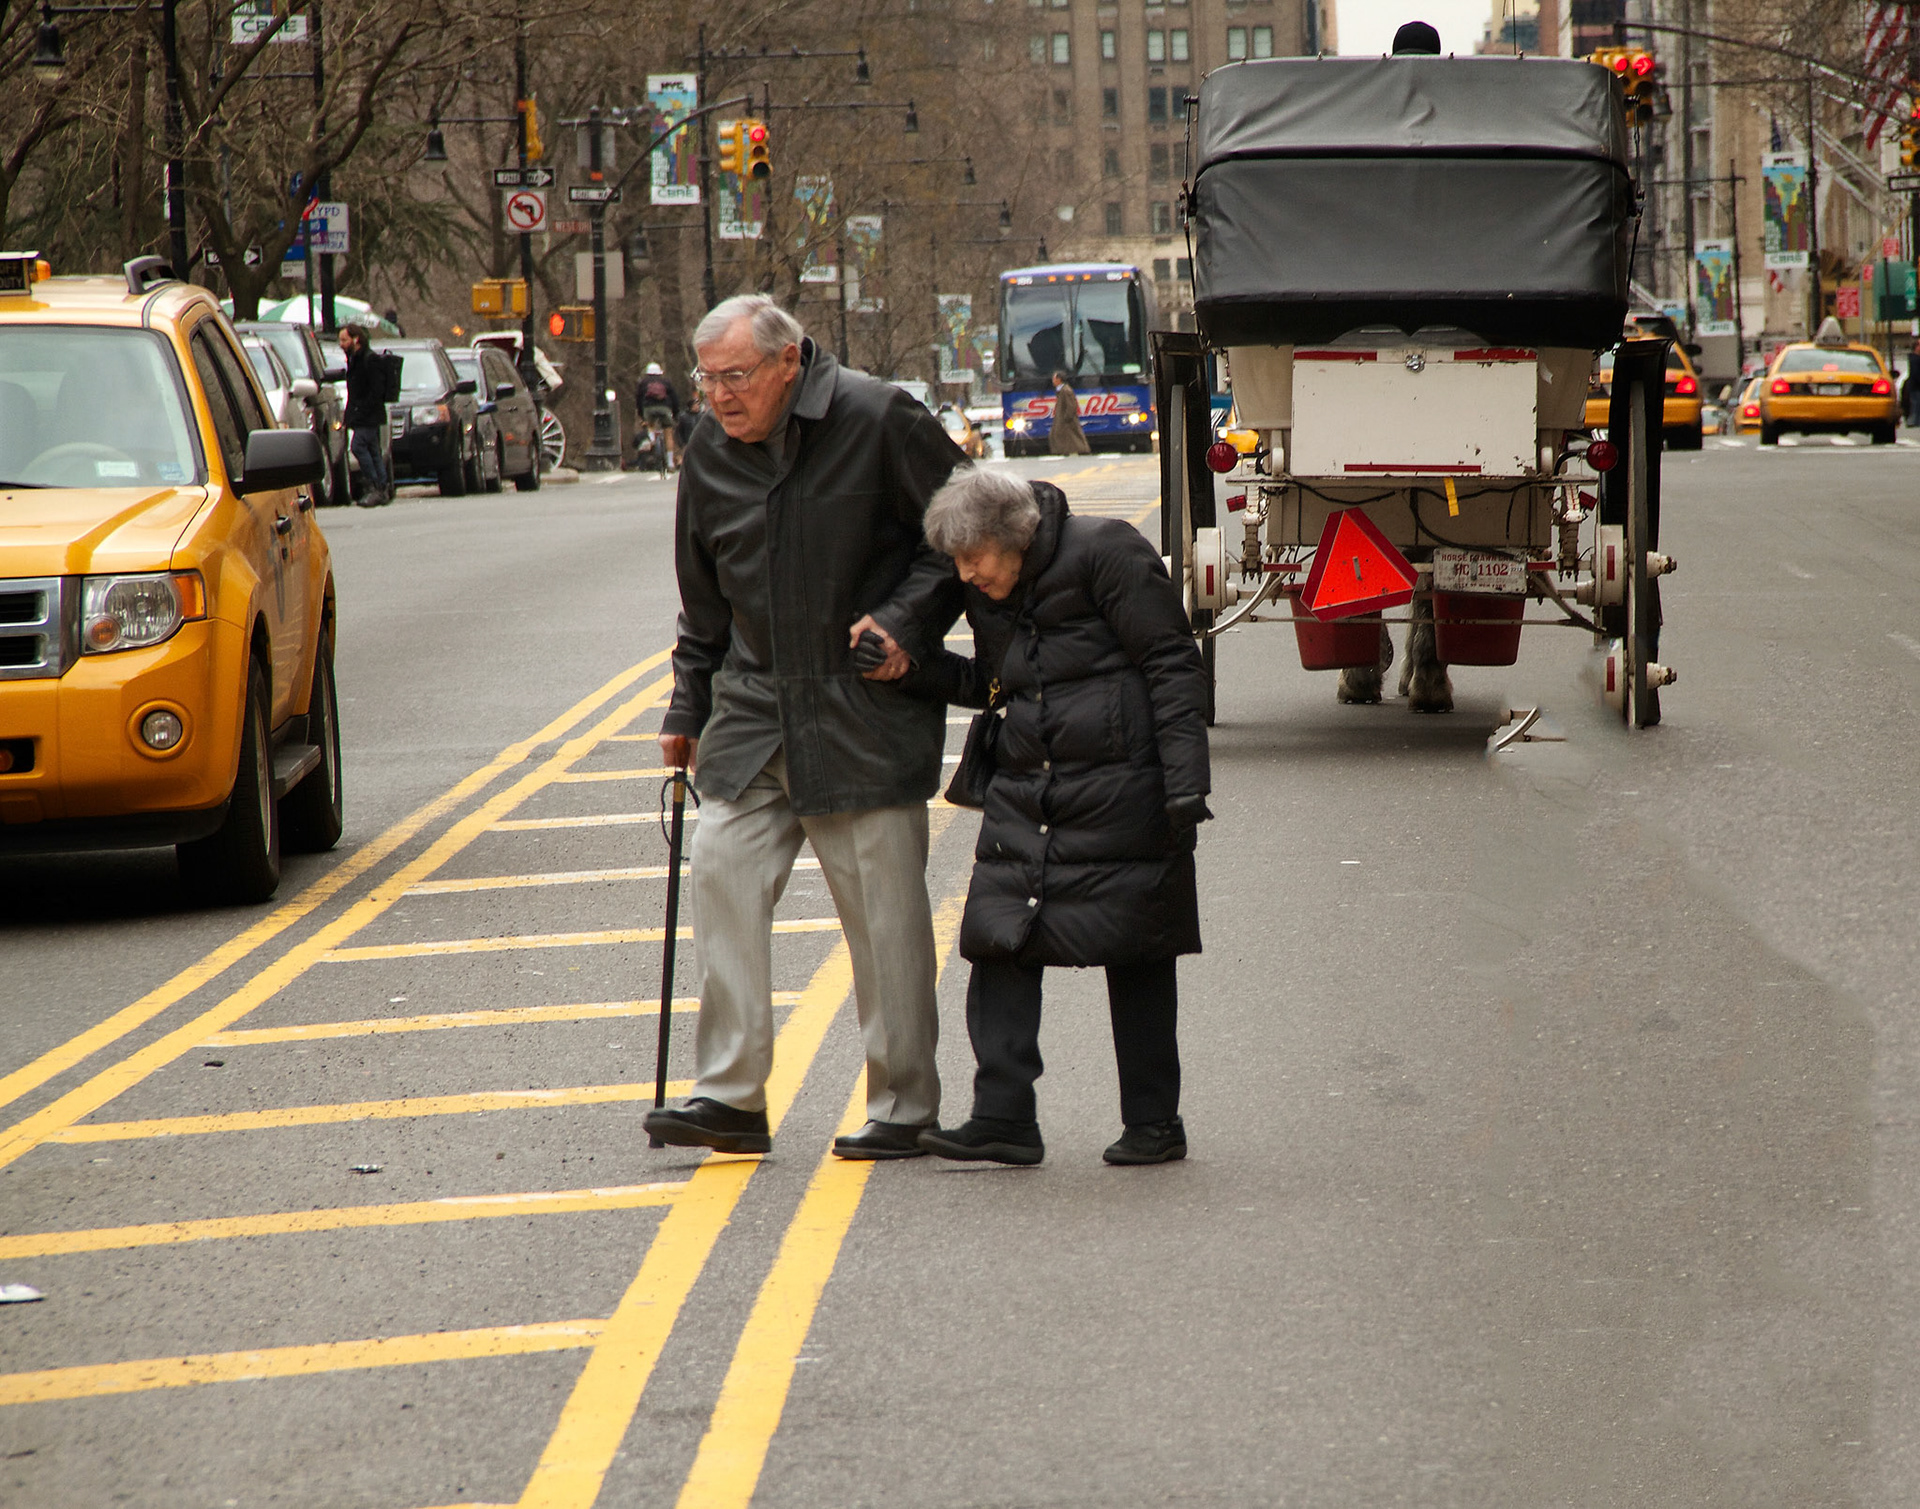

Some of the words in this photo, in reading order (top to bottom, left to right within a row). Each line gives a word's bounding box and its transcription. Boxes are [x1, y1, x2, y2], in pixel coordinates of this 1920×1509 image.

[241, 20, 297, 32] CBE
[657, 189, 694, 198] CBRE
[1454, 563, 1470, 576] HC
[1477, 563, 1509, 576] 1102
